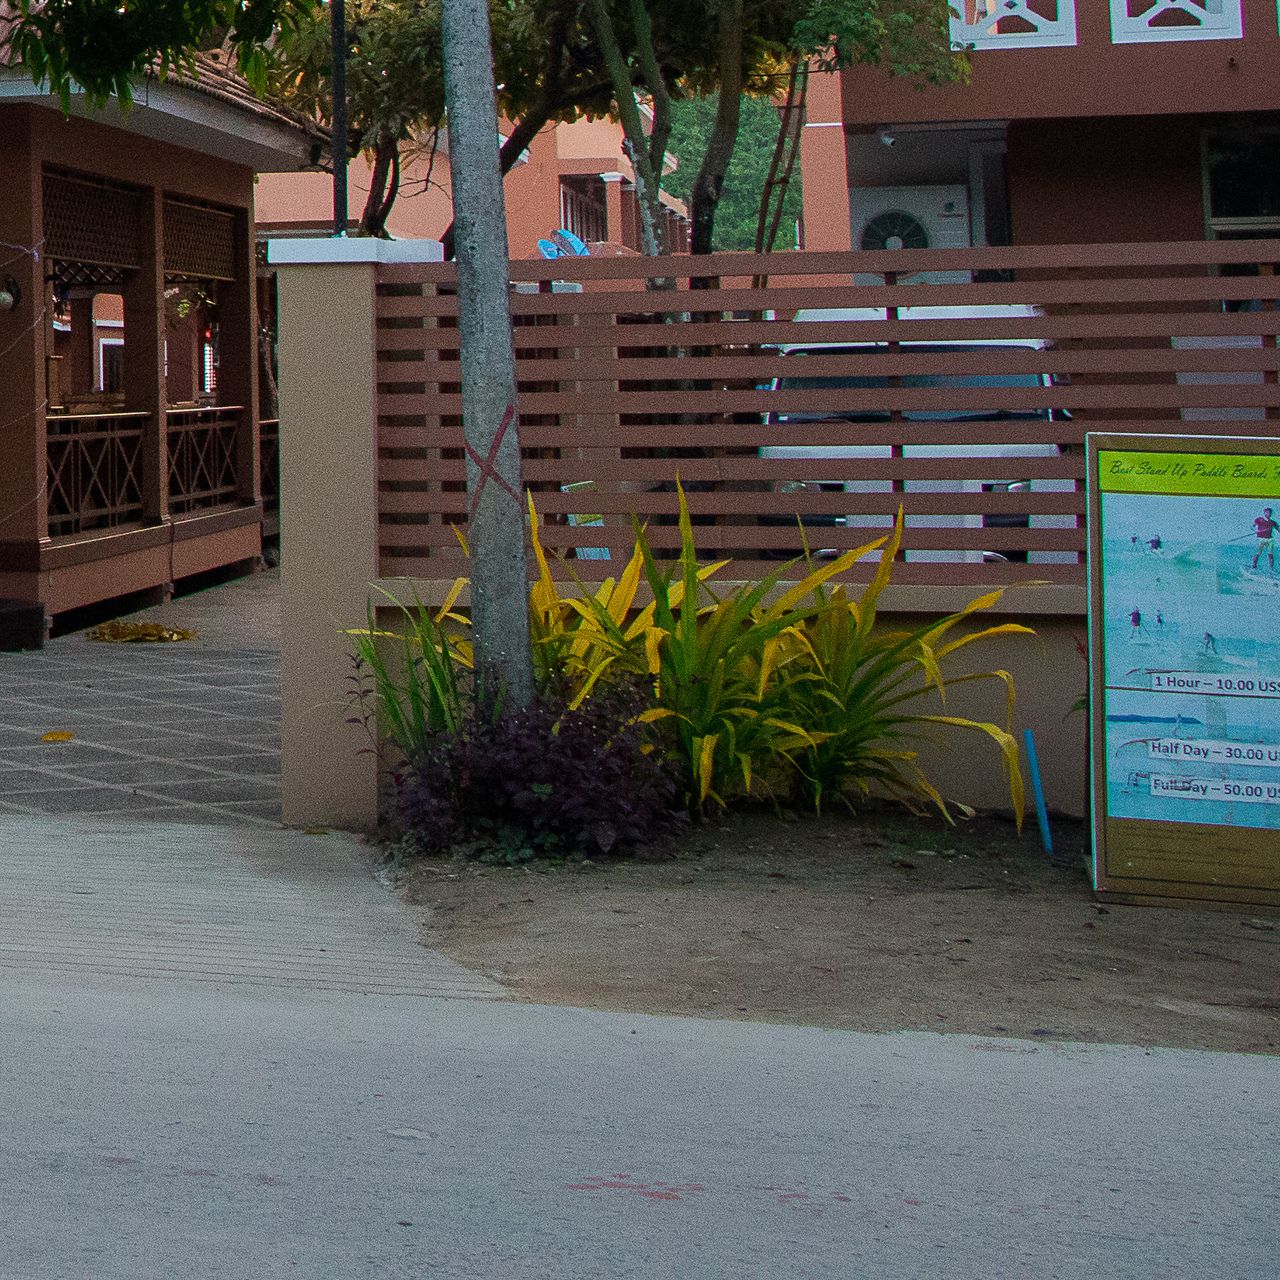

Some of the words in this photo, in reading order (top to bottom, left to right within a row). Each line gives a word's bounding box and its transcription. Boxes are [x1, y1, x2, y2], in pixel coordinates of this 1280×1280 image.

[1171, 463, 1188, 479] Up
[1155, 676, 1162, 687] 1
[1167, 677, 1200, 688] Hour
[1217, 679, 1254, 691] 10.00
[1151, 743, 1180, 754] Half
[1183, 745, 1209, 759] Day
[1225, 747, 1263, 761] 30.00
[1224, 784, 1262, 797] 50.00
